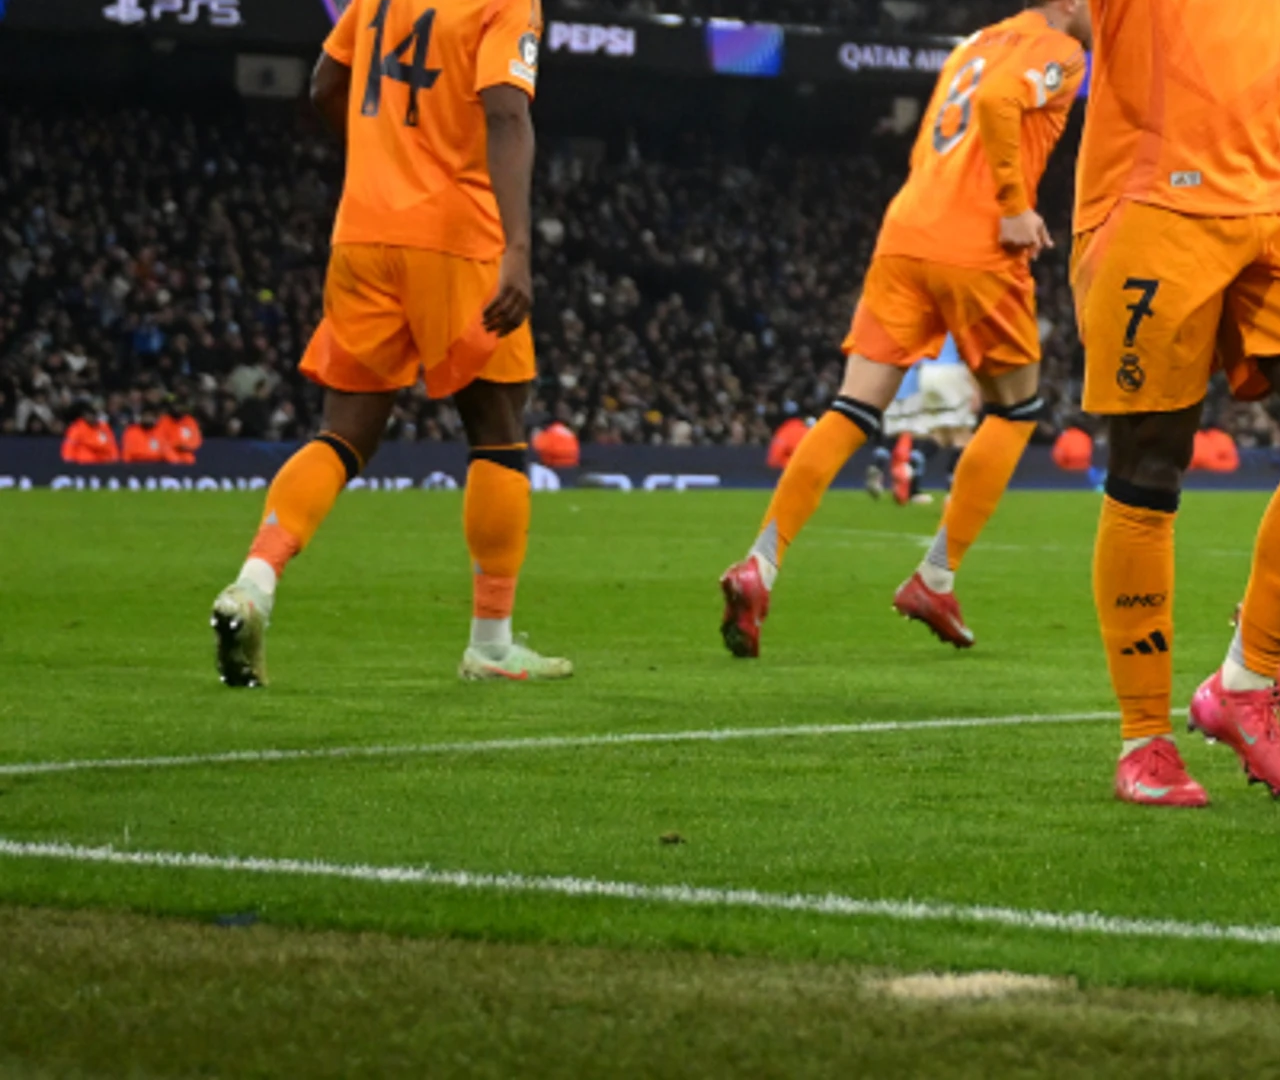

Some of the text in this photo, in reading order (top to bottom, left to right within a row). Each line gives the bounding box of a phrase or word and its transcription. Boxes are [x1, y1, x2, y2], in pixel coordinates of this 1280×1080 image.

[548, 21, 636, 57] PEPSI
[839, 42, 910, 70] QATAR
[932, 57, 986, 156] 8
[1122, 276, 1160, 348] 7
